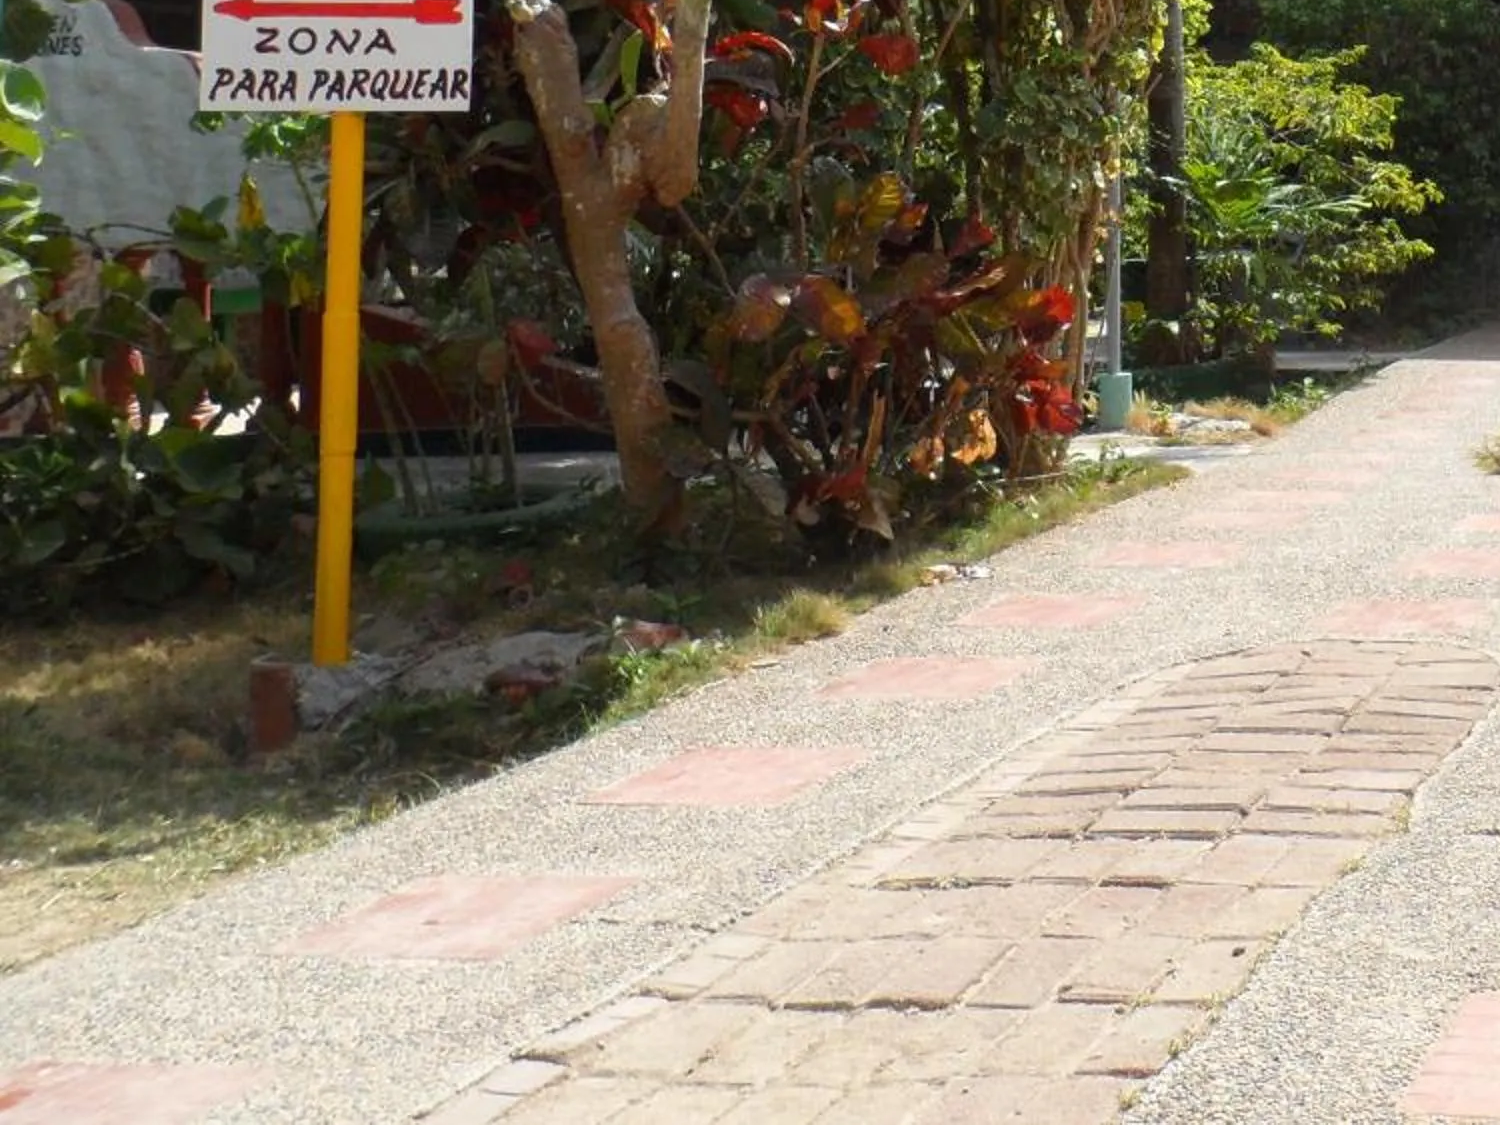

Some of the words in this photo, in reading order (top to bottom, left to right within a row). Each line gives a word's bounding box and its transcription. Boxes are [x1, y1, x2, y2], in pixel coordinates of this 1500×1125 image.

[254, 27, 396, 55] ZONA
[208, 68, 298, 101] PARA
[308, 69, 470, 101] PARQUEAR
